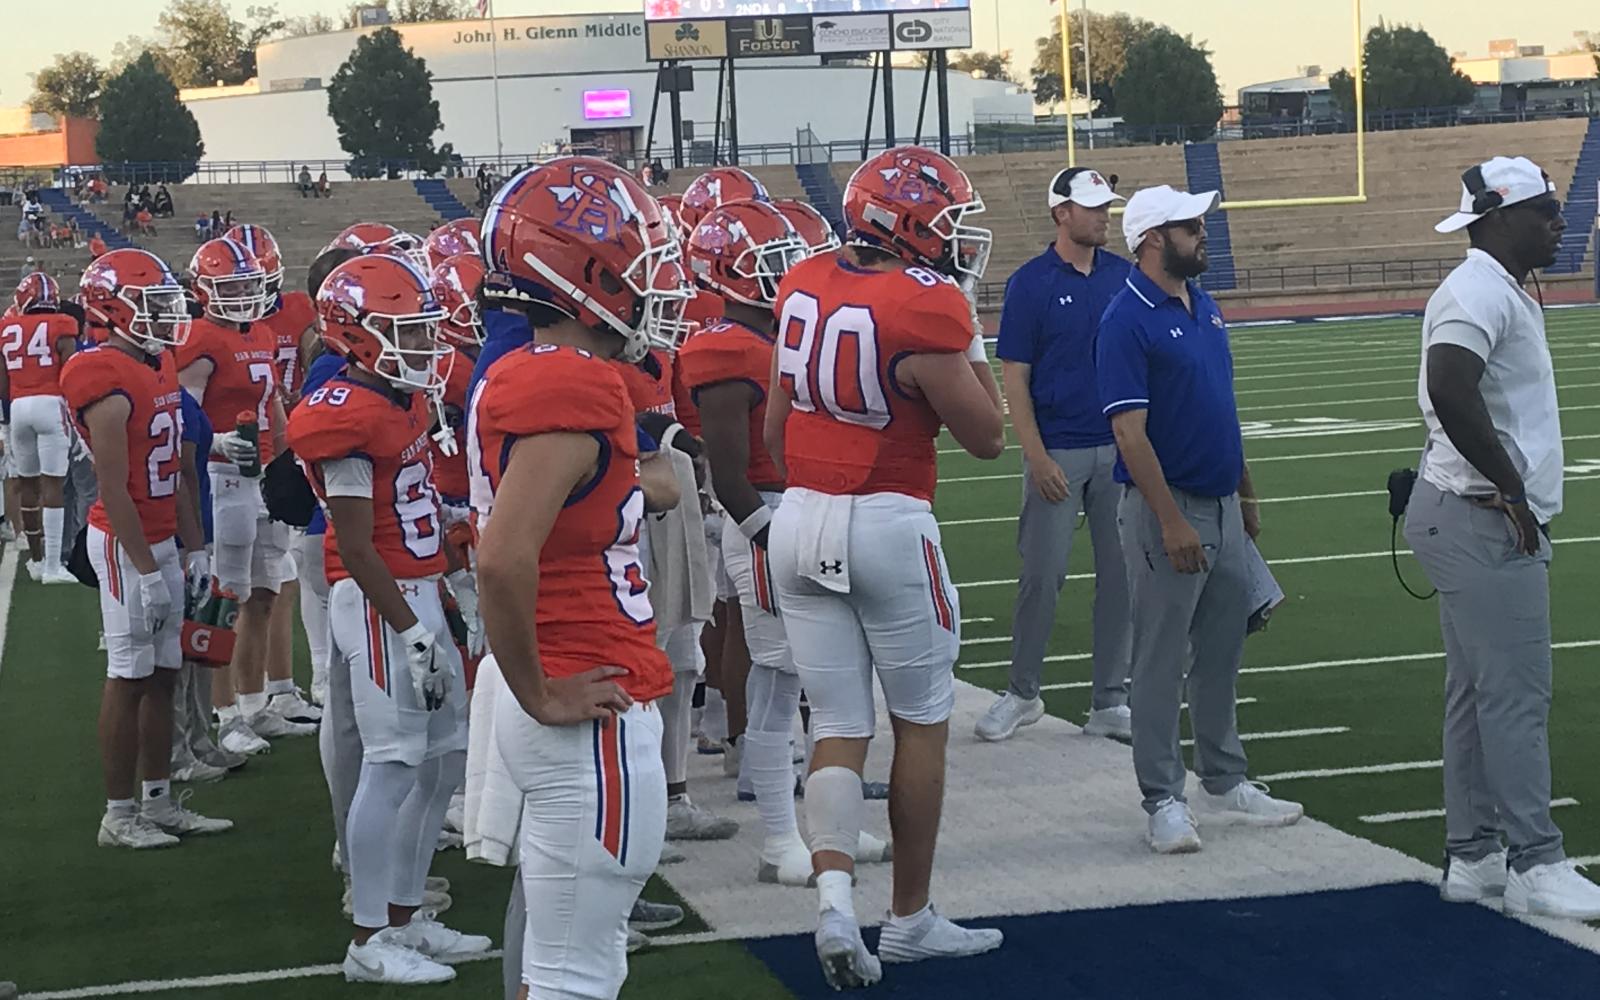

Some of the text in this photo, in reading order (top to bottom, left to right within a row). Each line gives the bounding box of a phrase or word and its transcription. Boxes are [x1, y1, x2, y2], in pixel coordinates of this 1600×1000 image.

[453, 22, 642, 44] John H. Glenn Middle
[739, 38, 801, 51] Foster
[664, 43, 713, 58] SHANNON
[1, 321, 53, 371] 24
[777, 290, 892, 430] 80
[249, 363, 274, 431] 7
[308, 386, 352, 406] 89
[191, 628, 212, 653] G
